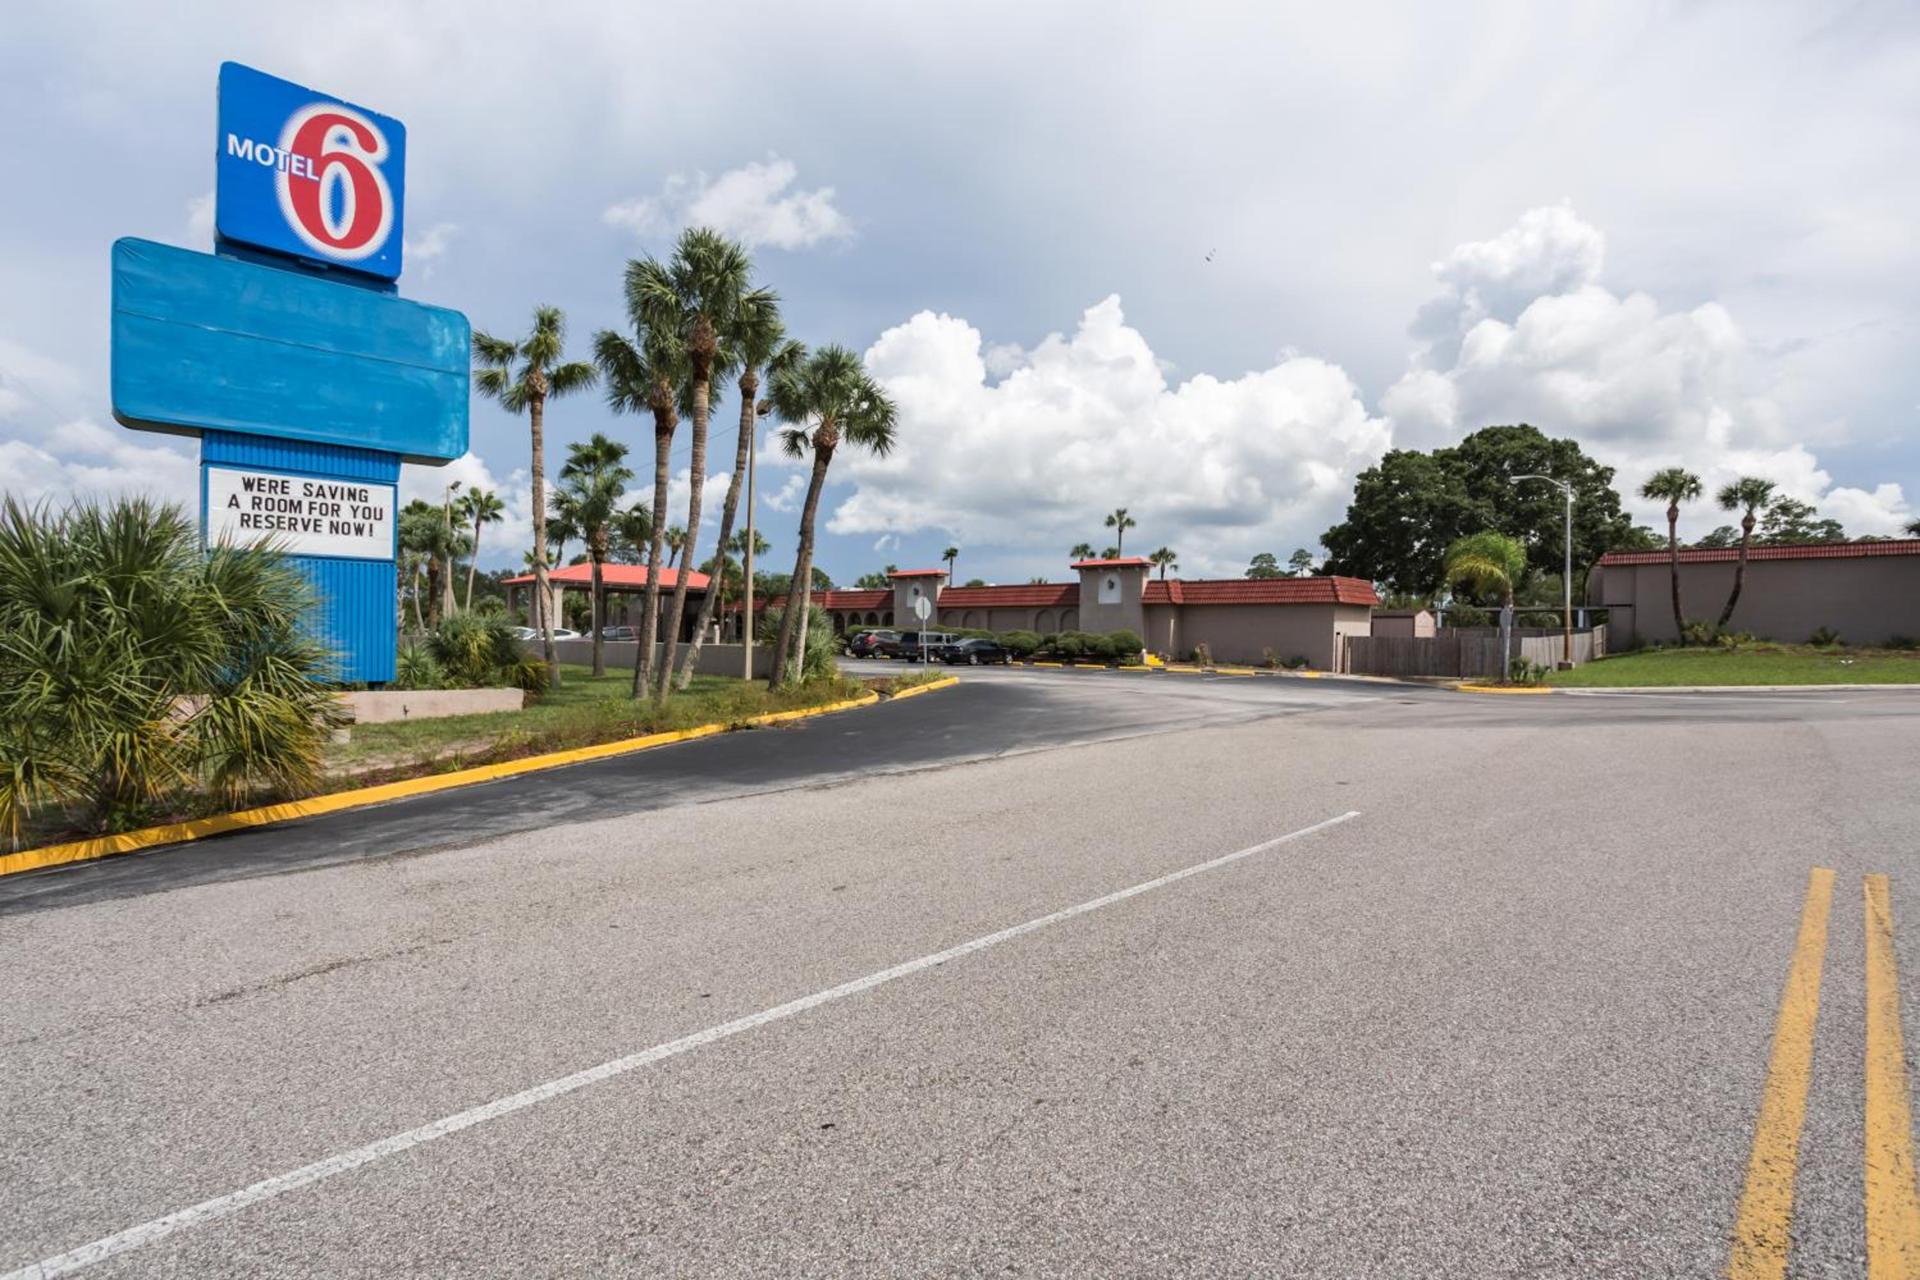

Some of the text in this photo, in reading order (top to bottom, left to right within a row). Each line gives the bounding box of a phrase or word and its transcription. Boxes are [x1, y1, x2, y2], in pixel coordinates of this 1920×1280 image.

[227, 107, 390, 255] MOTEL 6
[242, 477, 369, 503] WERE SAVING
[228, 494, 384, 521] A ROOM FOR YOU
[240, 513, 374, 537] RESERVE NOW!
